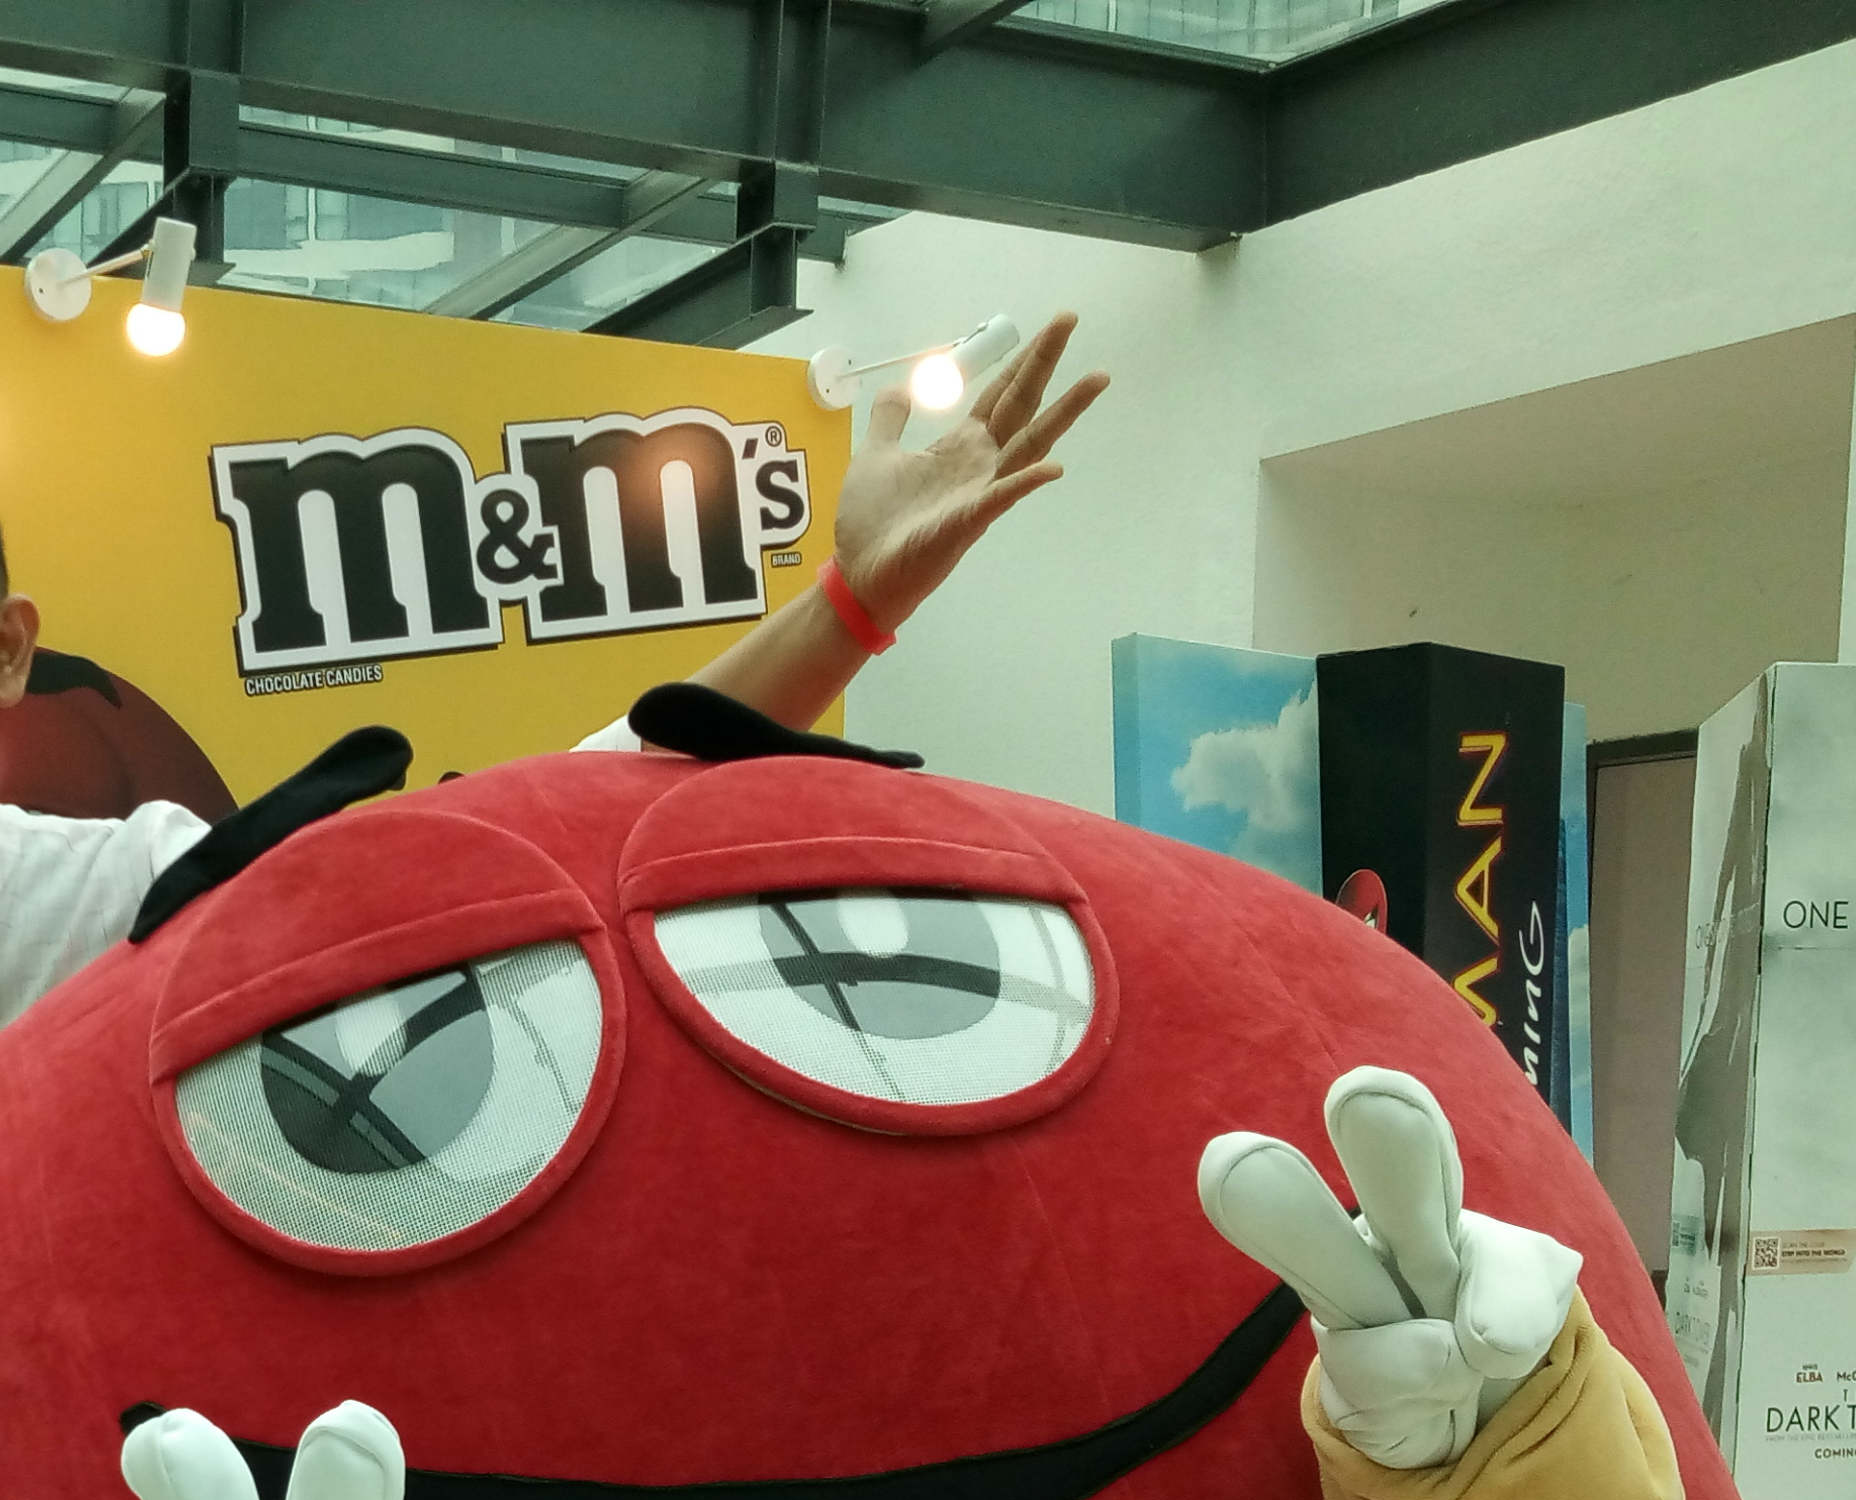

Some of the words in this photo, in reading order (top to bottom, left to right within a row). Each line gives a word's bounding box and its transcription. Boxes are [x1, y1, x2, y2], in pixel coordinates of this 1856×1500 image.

[772, 553, 802, 567] BRAND
[246, 671, 324, 695] CHOCOLATE
[326, 664, 383, 687] CANDIES
[1783, 900, 1849, 930] ONE
[1795, 1371, 1824, 1383] ELBA
[1766, 1404, 1841, 1433] DARK
[1814, 1447, 1856, 1459] COMIN
